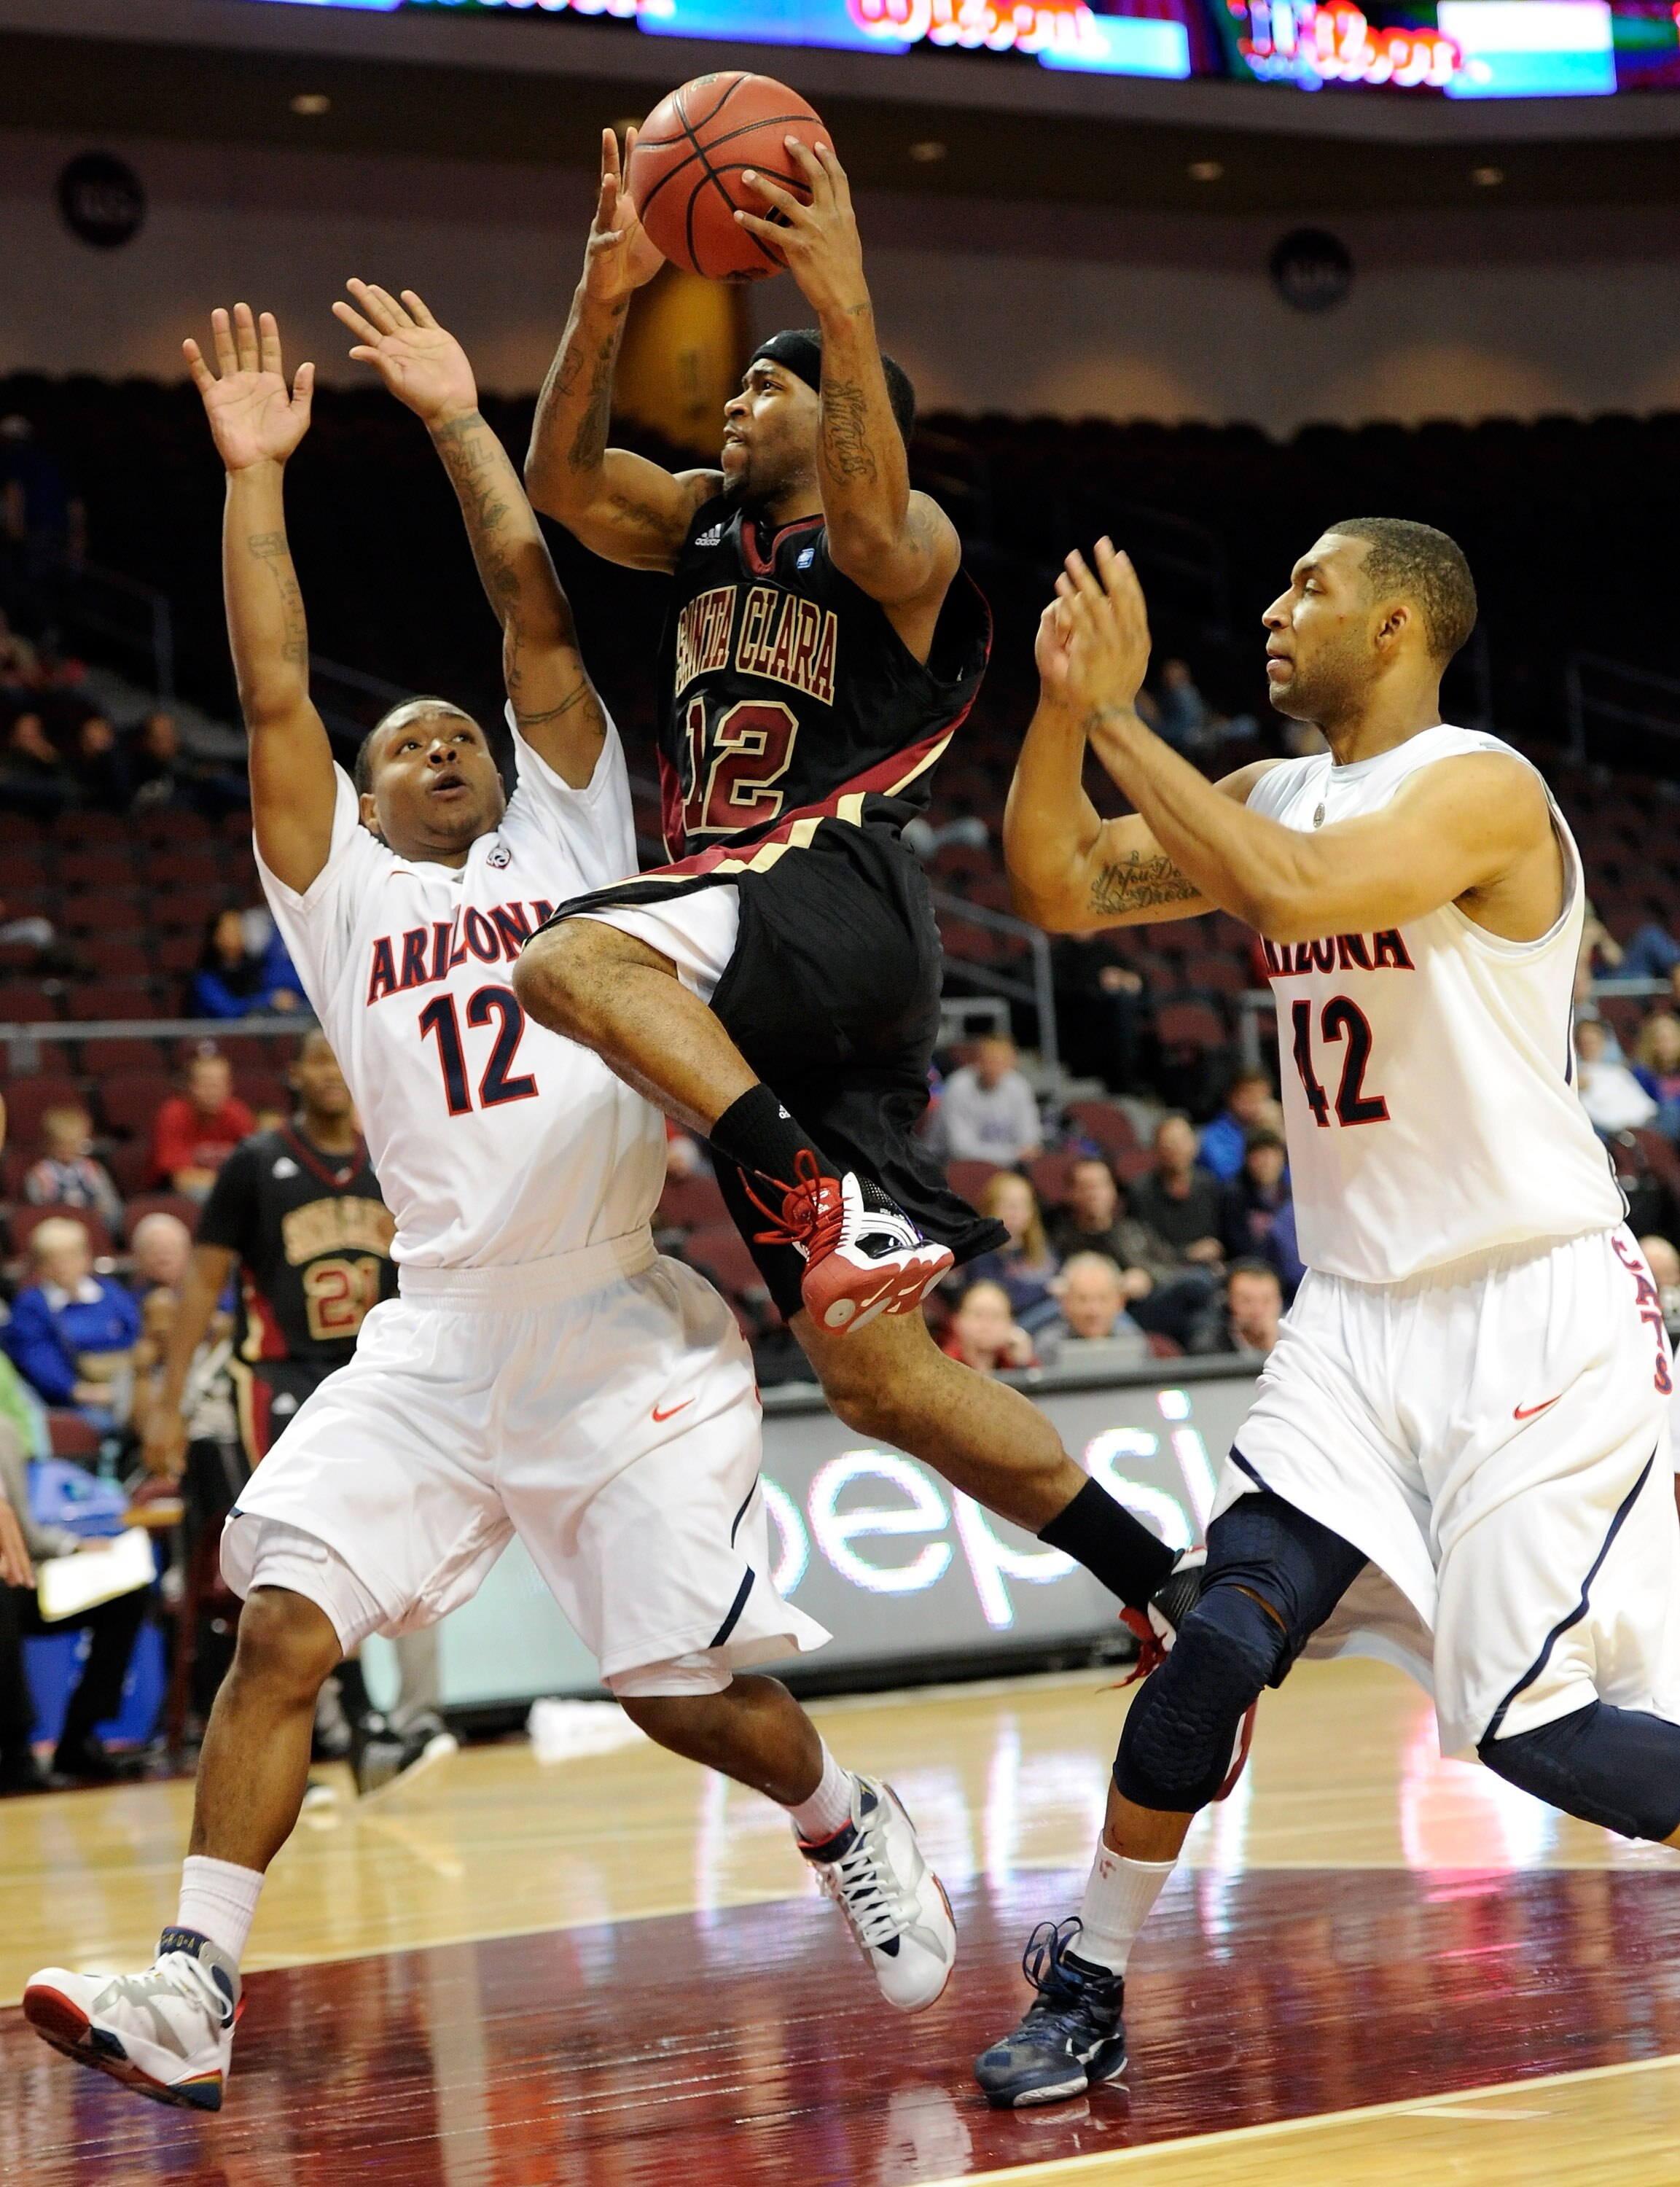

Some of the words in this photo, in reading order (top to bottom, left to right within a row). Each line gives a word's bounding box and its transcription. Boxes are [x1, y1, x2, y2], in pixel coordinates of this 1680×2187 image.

[695, 538, 721, 546] adidas
[675, 585, 738, 698] SANTA
[735, 586, 837, 707] CLARA
[682, 696, 800, 837] 12
[418, 984, 540, 1117] 12
[302, 1257, 382, 1341] 21
[1611, 1235, 1673, 1395] CATS
